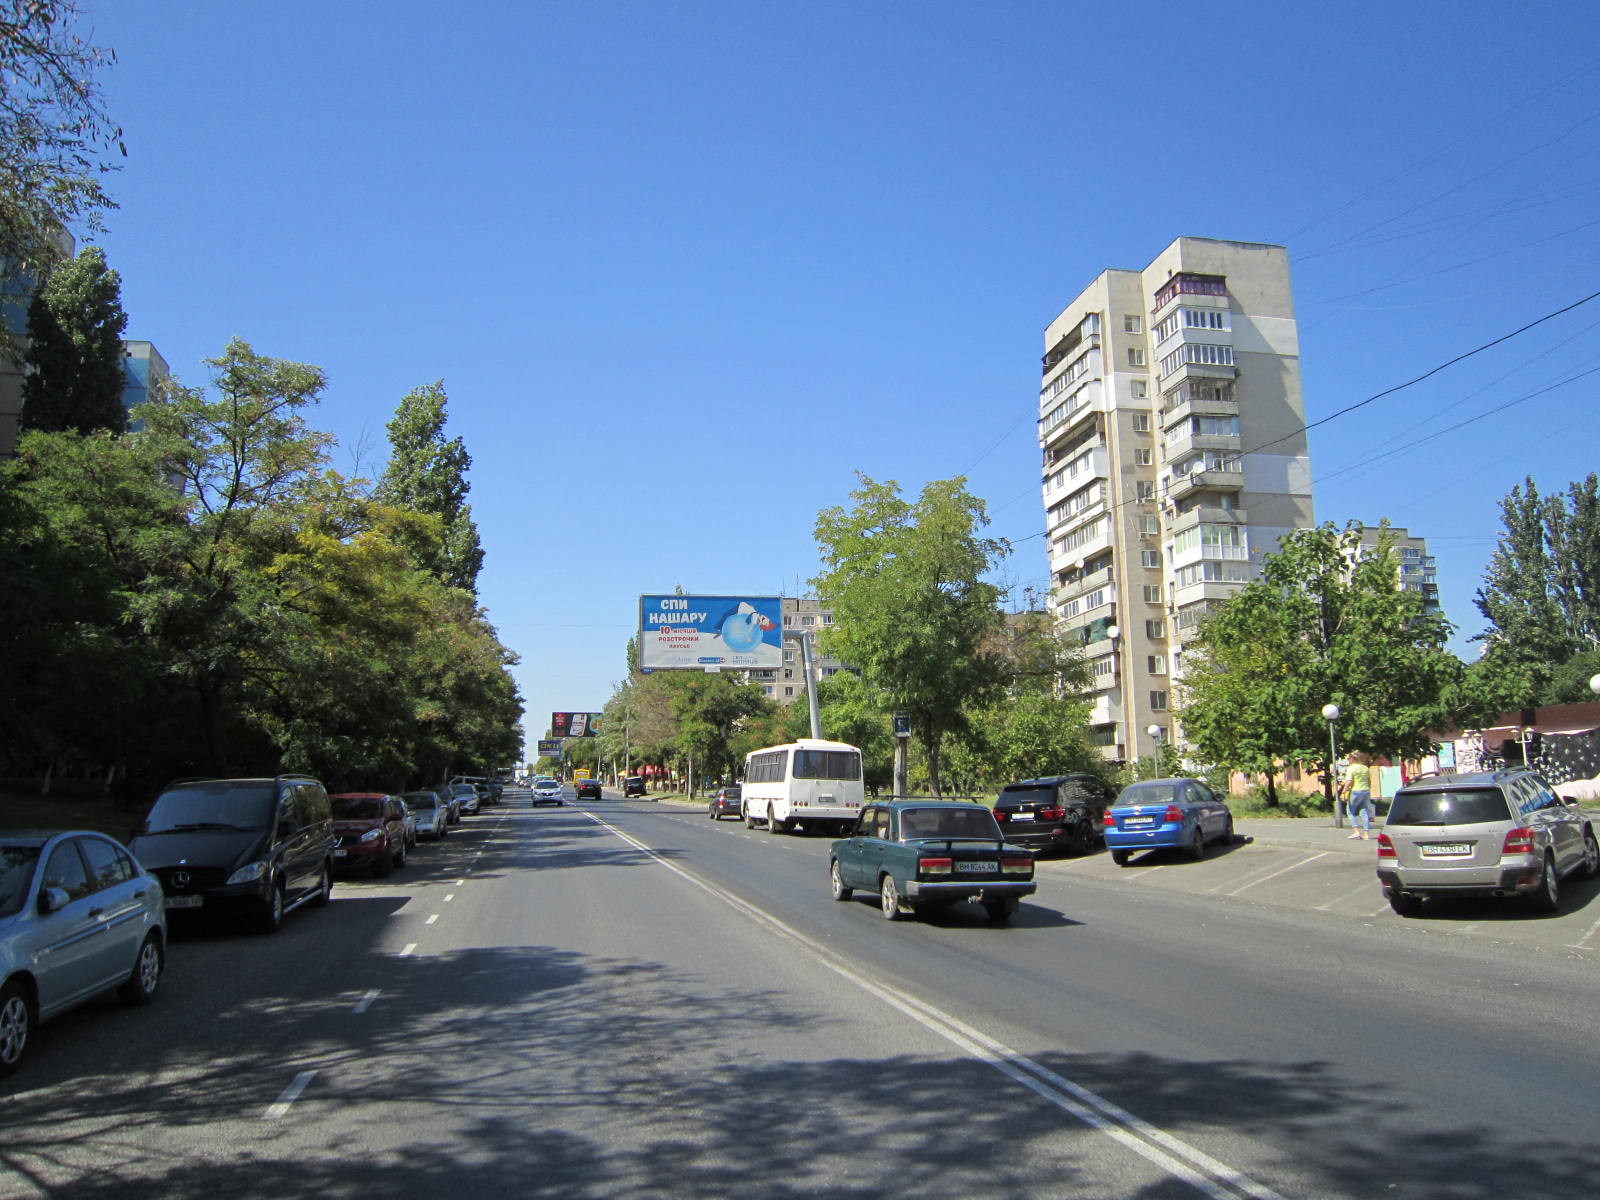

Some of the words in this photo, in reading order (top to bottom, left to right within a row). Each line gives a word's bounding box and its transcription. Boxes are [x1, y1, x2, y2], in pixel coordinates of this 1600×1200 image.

[660, 599, 688, 610] СПИ
[649, 612, 707, 624] НАШАРУ
[660, 626, 671, 635] 10
